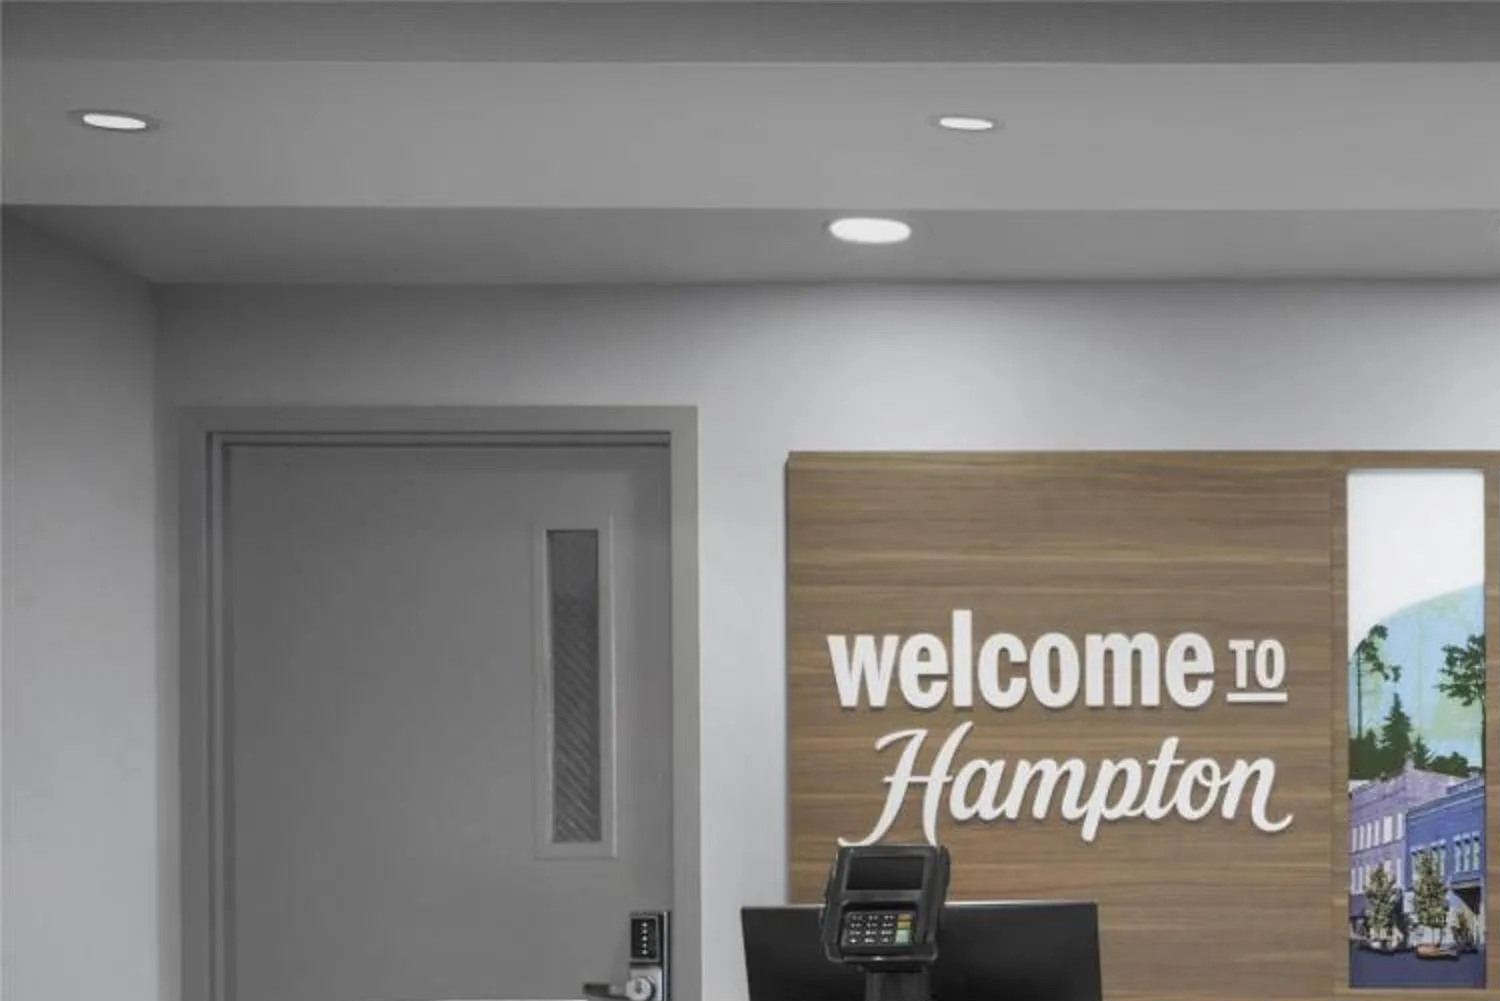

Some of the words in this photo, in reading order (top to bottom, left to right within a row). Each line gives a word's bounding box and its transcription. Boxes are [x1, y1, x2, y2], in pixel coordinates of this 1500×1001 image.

[827, 609, 1215, 709] welcome
[1228, 639, 1287, 690] TO
[837, 721, 1294, 842] Hampton
